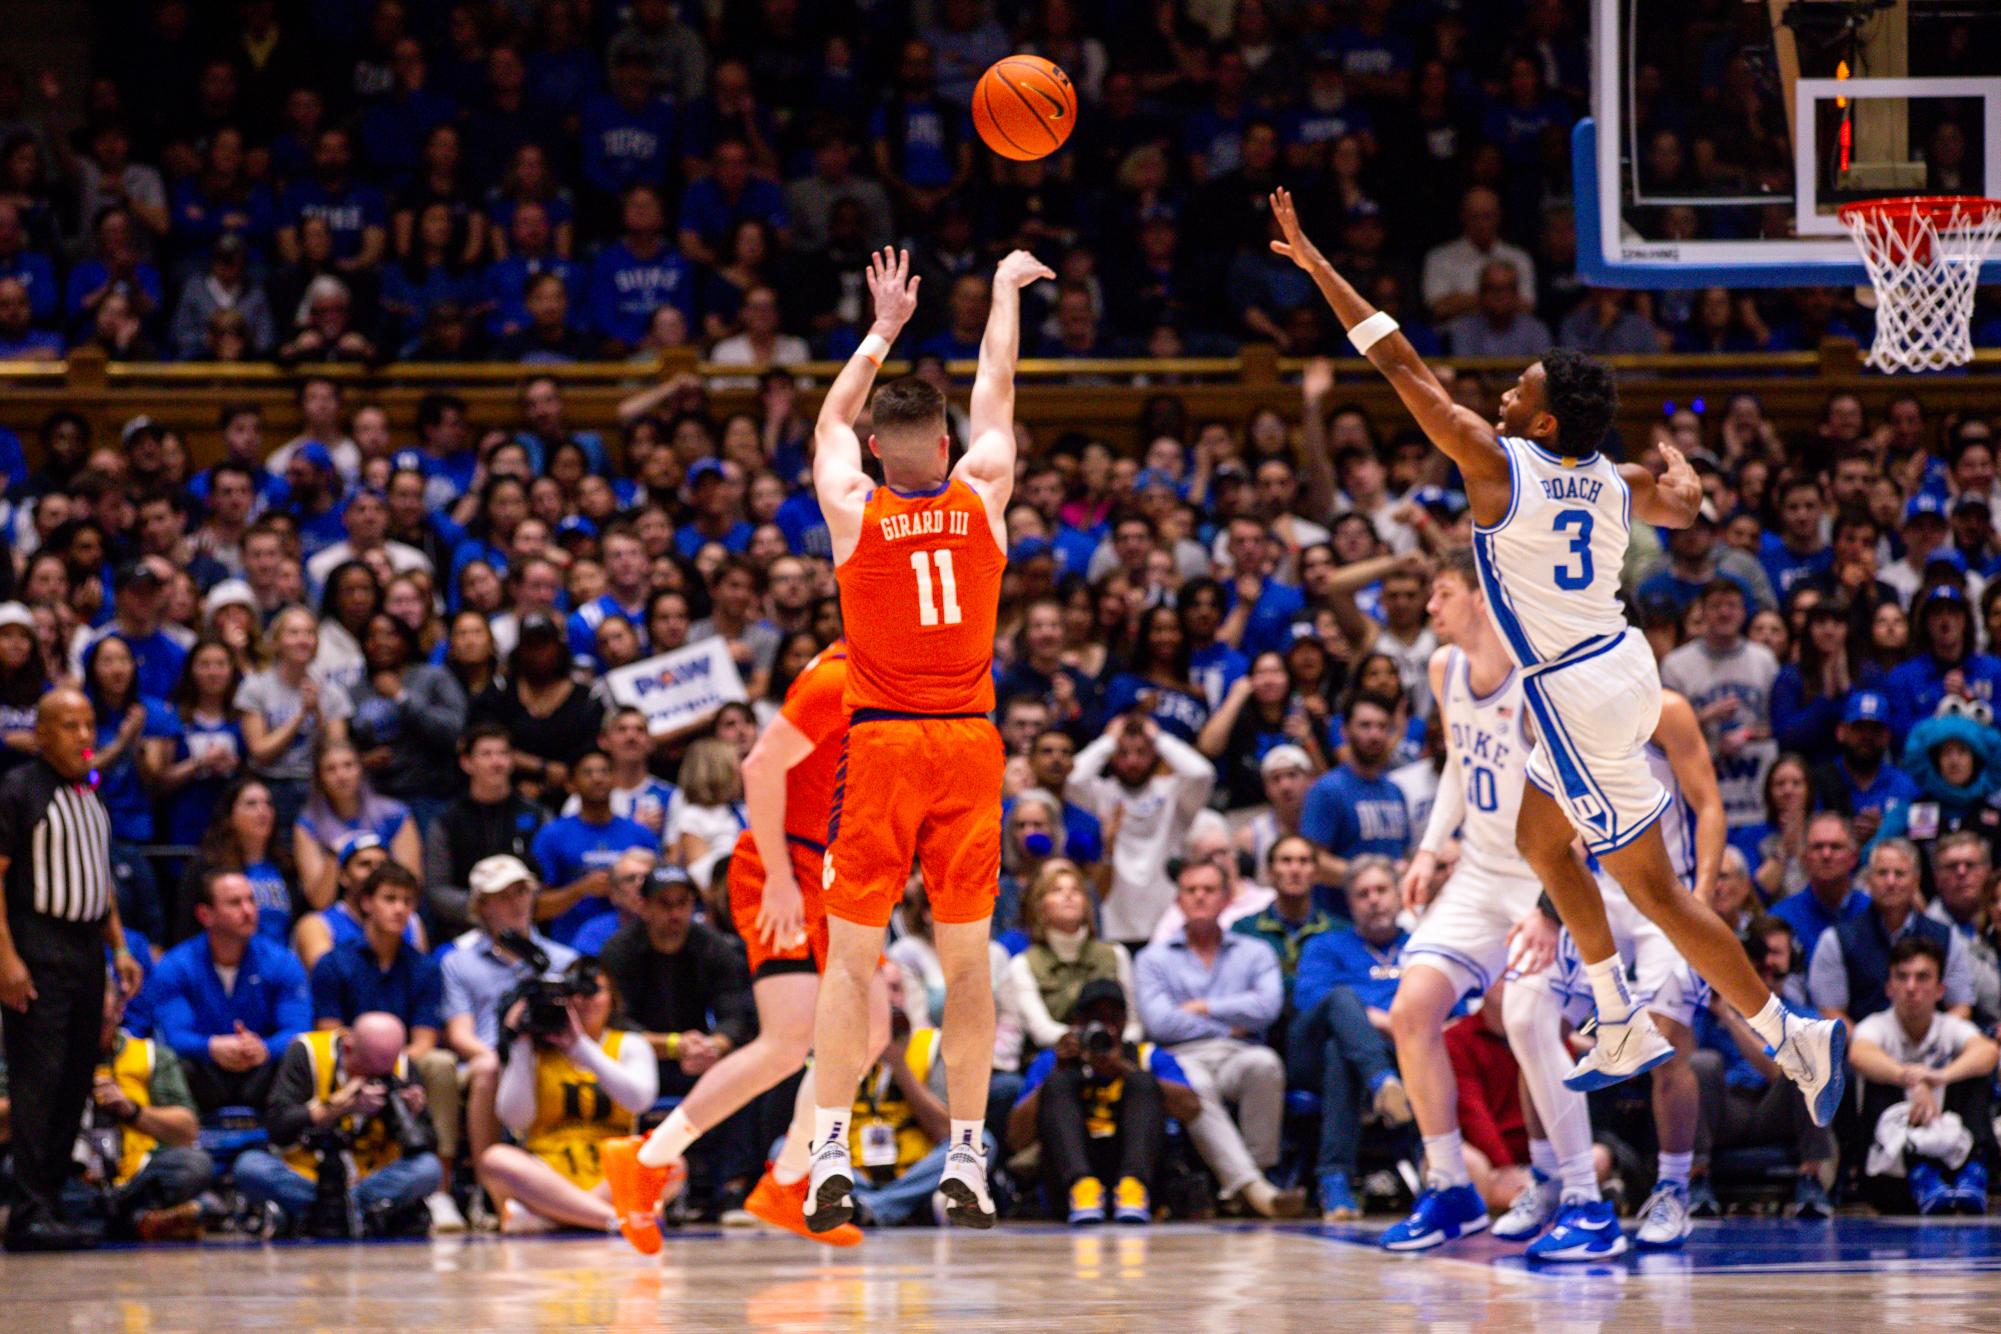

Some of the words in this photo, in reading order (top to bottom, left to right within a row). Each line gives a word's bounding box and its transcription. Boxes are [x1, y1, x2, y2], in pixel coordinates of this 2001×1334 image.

[1540, 476, 1603, 504] ROACH
[880, 509, 944, 541] GIRARD
[949, 509, 970, 536] III
[1552, 509, 1594, 591] 3
[910, 548, 962, 626] 11
